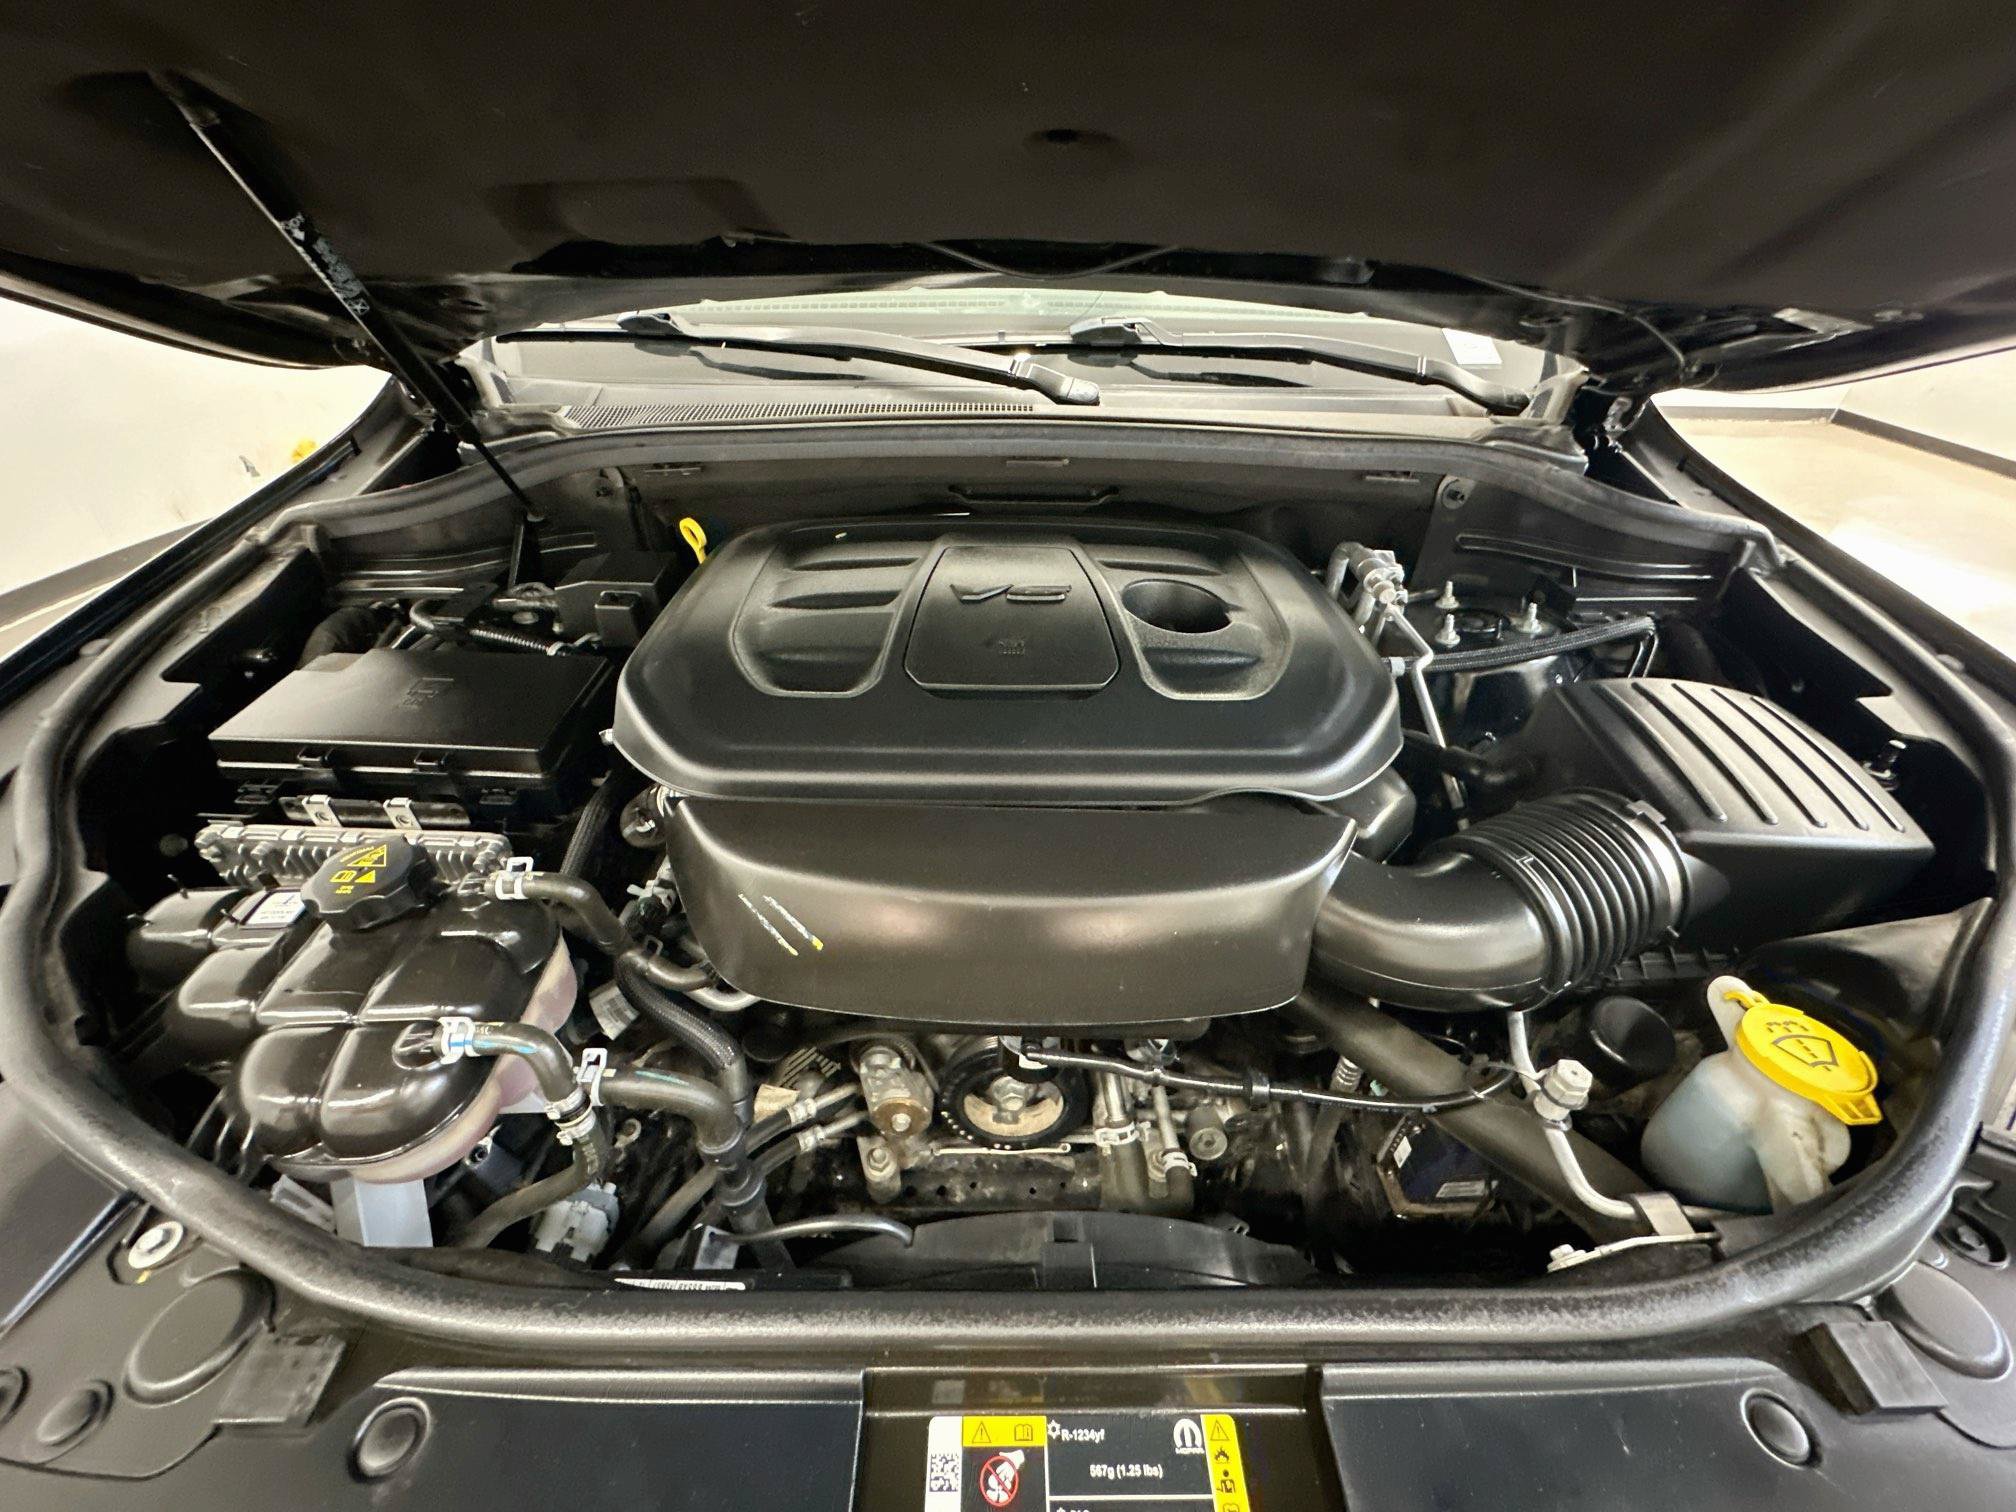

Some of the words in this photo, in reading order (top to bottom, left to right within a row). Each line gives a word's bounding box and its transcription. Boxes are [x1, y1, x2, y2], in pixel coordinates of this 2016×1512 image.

[1061, 1428, 1105, 1444] R-1234yf
[1116, 1463, 1142, 1479] (1.25
[1143, 1463, 1163, 1479] lbs)
